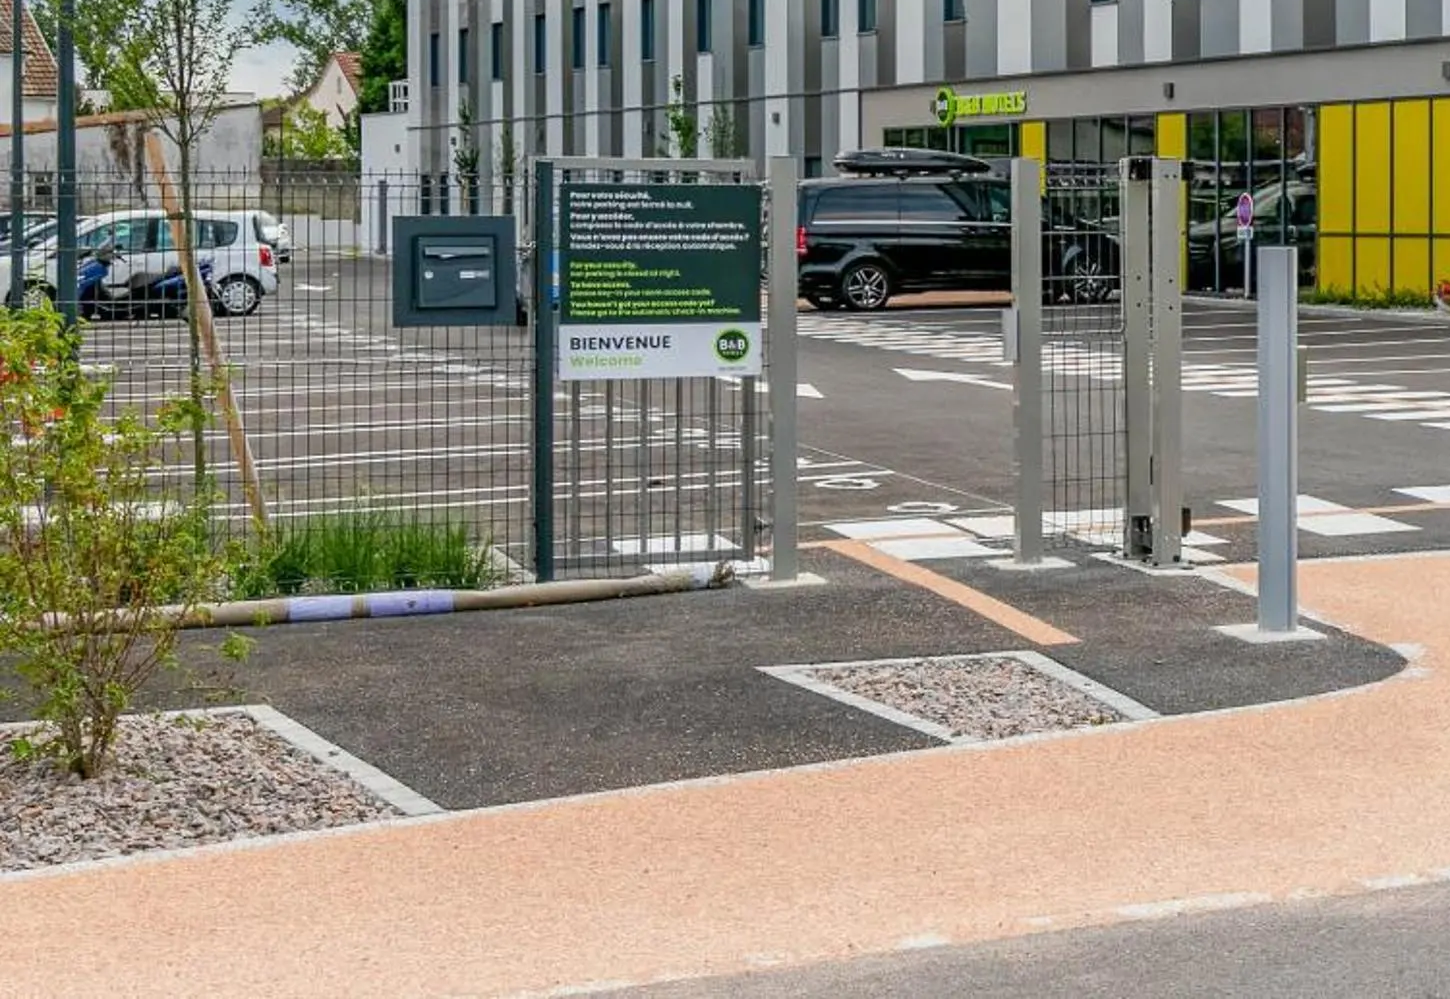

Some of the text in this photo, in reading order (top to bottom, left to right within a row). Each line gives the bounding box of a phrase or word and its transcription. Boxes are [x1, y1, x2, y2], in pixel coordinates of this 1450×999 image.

[570, 335, 672, 351] BIENVENUE
[718, 338, 745, 351] B&B
[570, 354, 644, 367] Welcome
